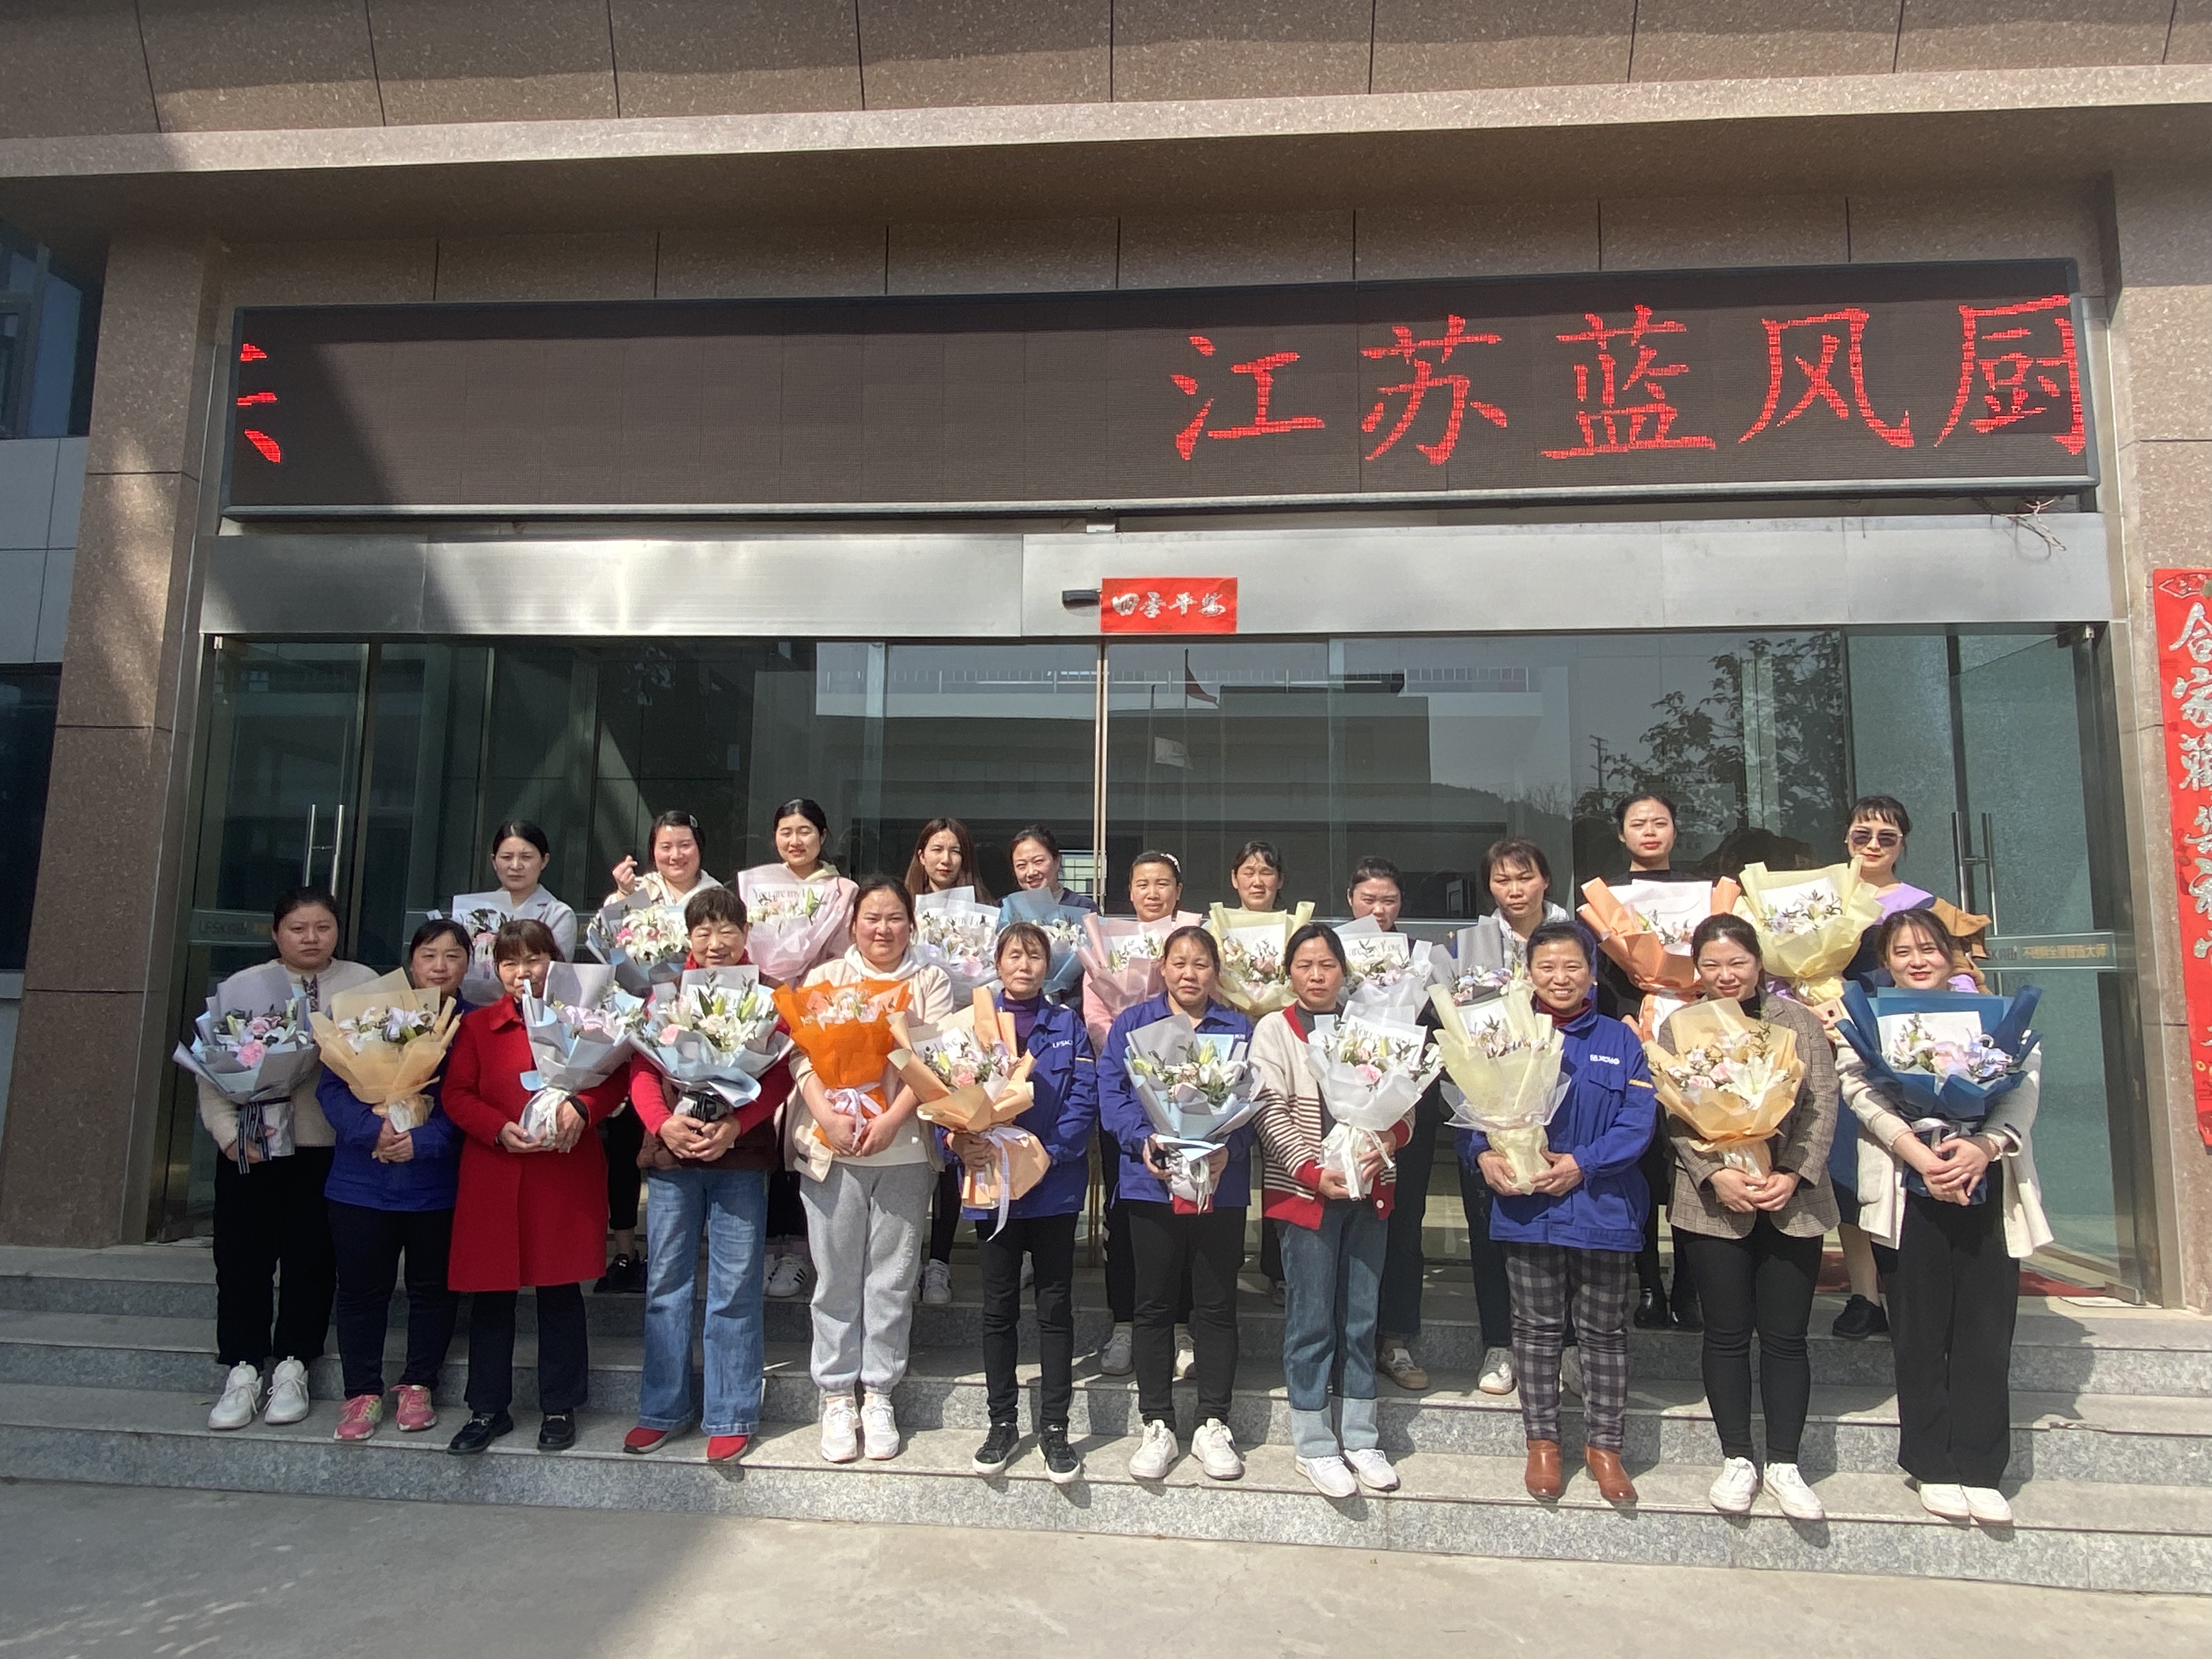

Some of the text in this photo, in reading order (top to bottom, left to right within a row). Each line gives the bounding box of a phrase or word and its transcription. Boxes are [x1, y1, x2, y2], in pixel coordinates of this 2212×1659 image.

[1171, 295, 2086, 465] 江苏蓝风厨
